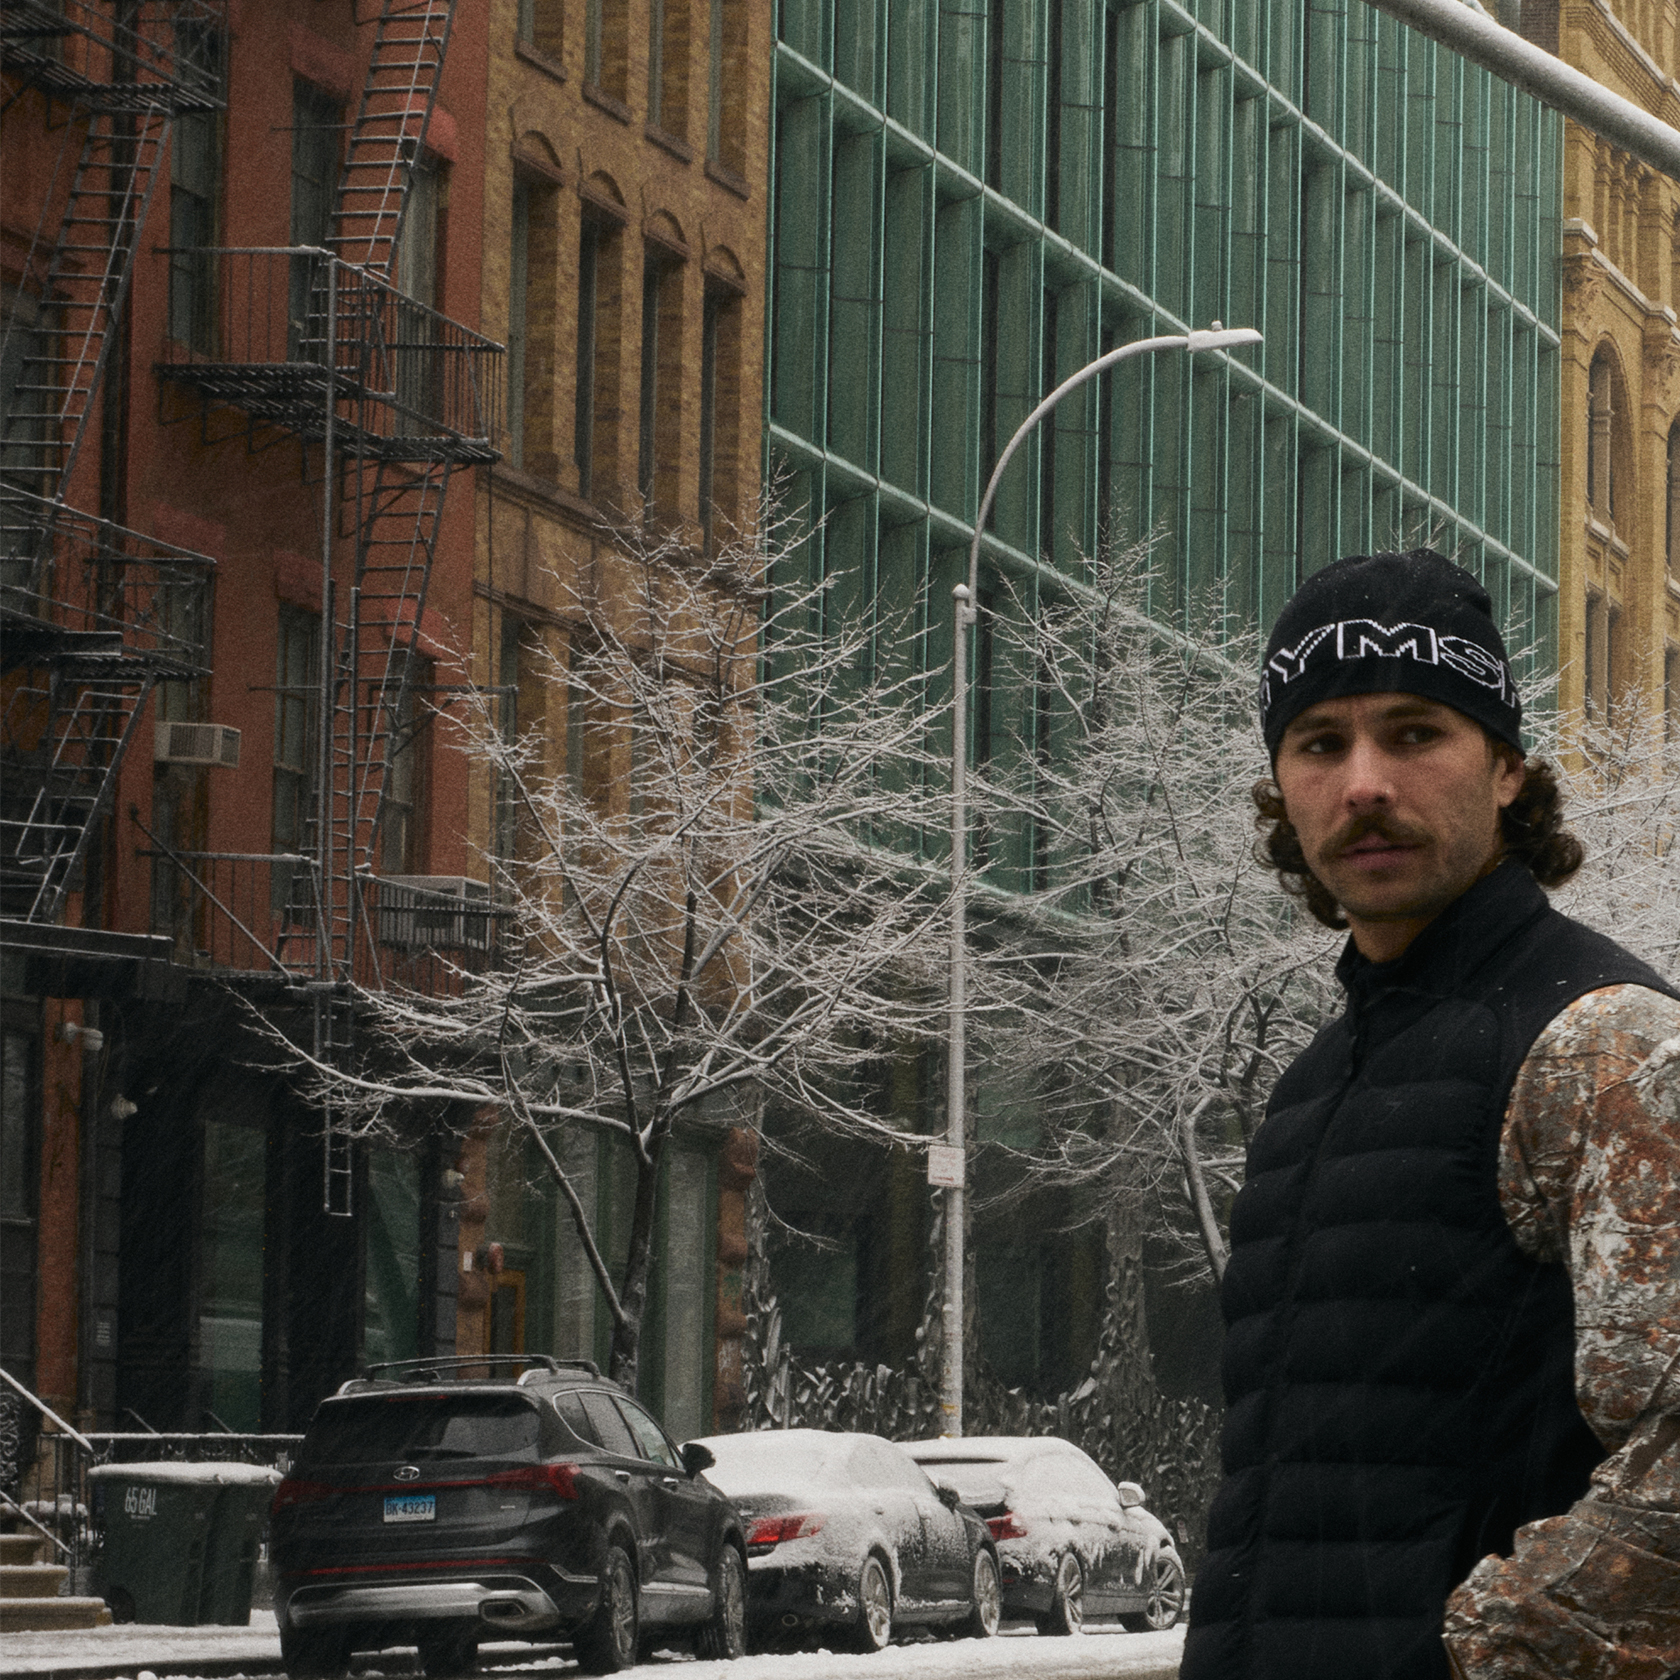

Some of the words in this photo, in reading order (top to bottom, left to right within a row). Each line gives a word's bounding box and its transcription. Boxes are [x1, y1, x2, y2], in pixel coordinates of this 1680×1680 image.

[1260, 618, 1519, 710] YMS
[124, 1486, 139, 1513] 65
[139, 1487, 158, 1516] GAL
